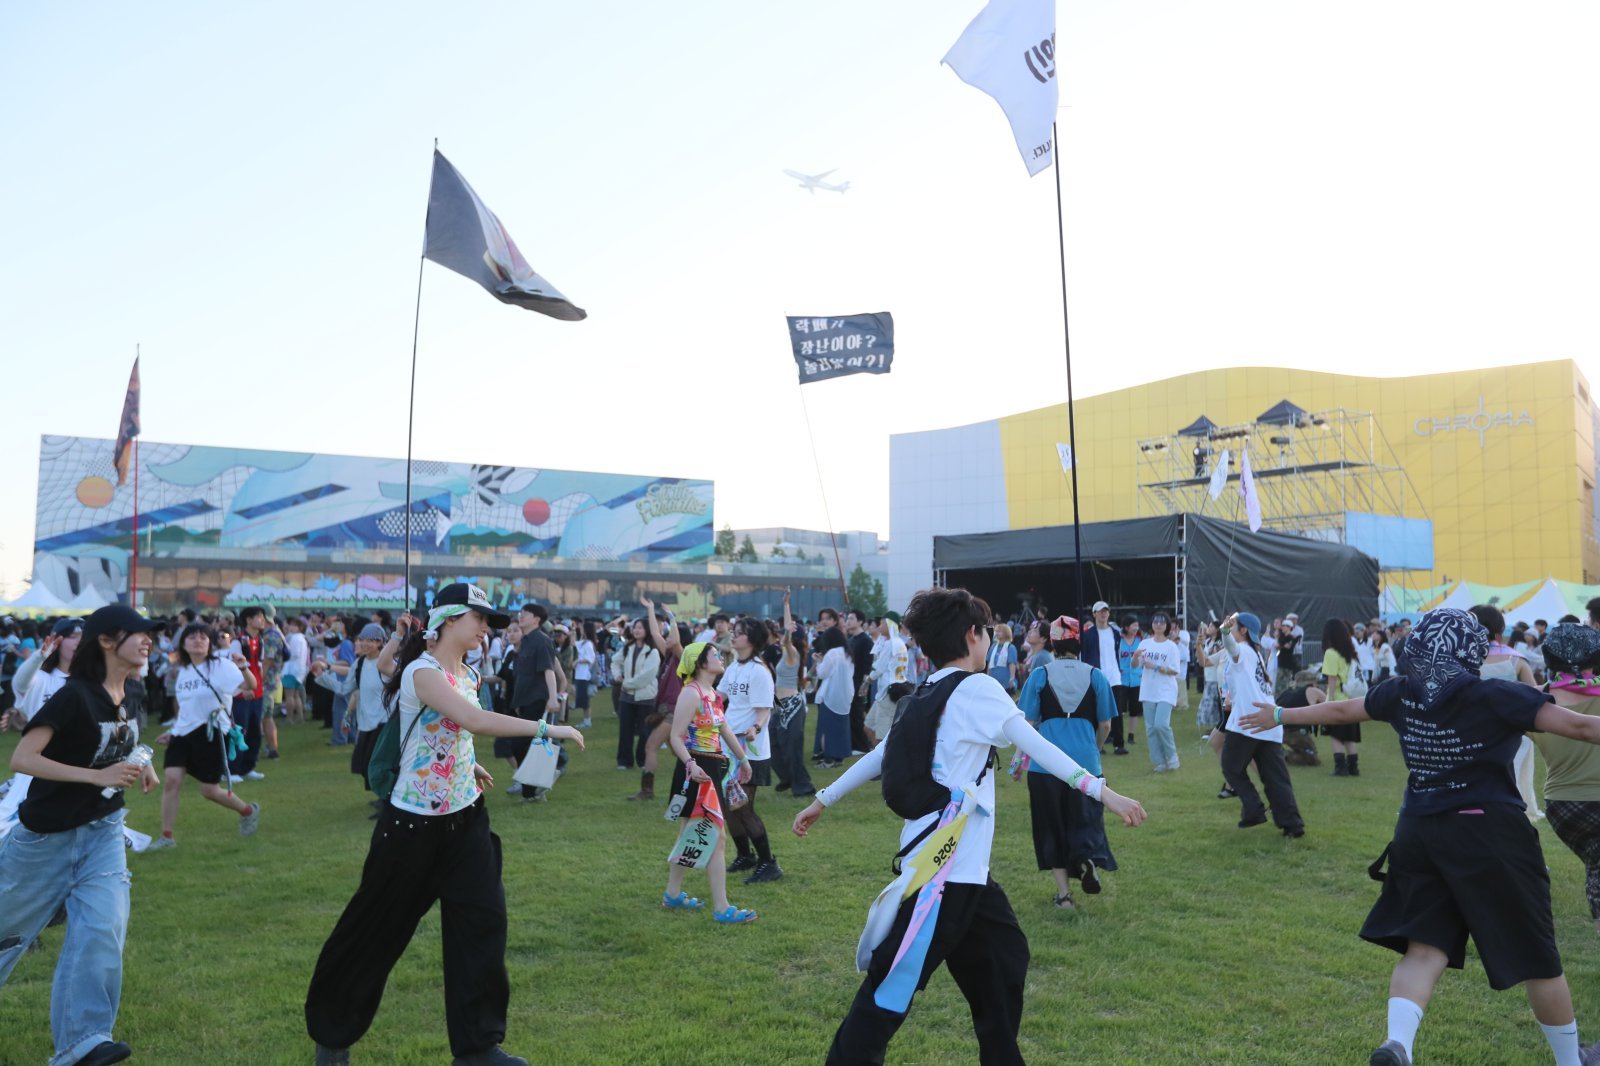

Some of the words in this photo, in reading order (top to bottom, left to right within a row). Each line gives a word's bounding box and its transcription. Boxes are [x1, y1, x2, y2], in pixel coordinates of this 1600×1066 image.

[800, 334, 877, 355] 장난이야?
[1413, 403, 1535, 442] CHROMA
[933, 835, 957, 867] 2026
